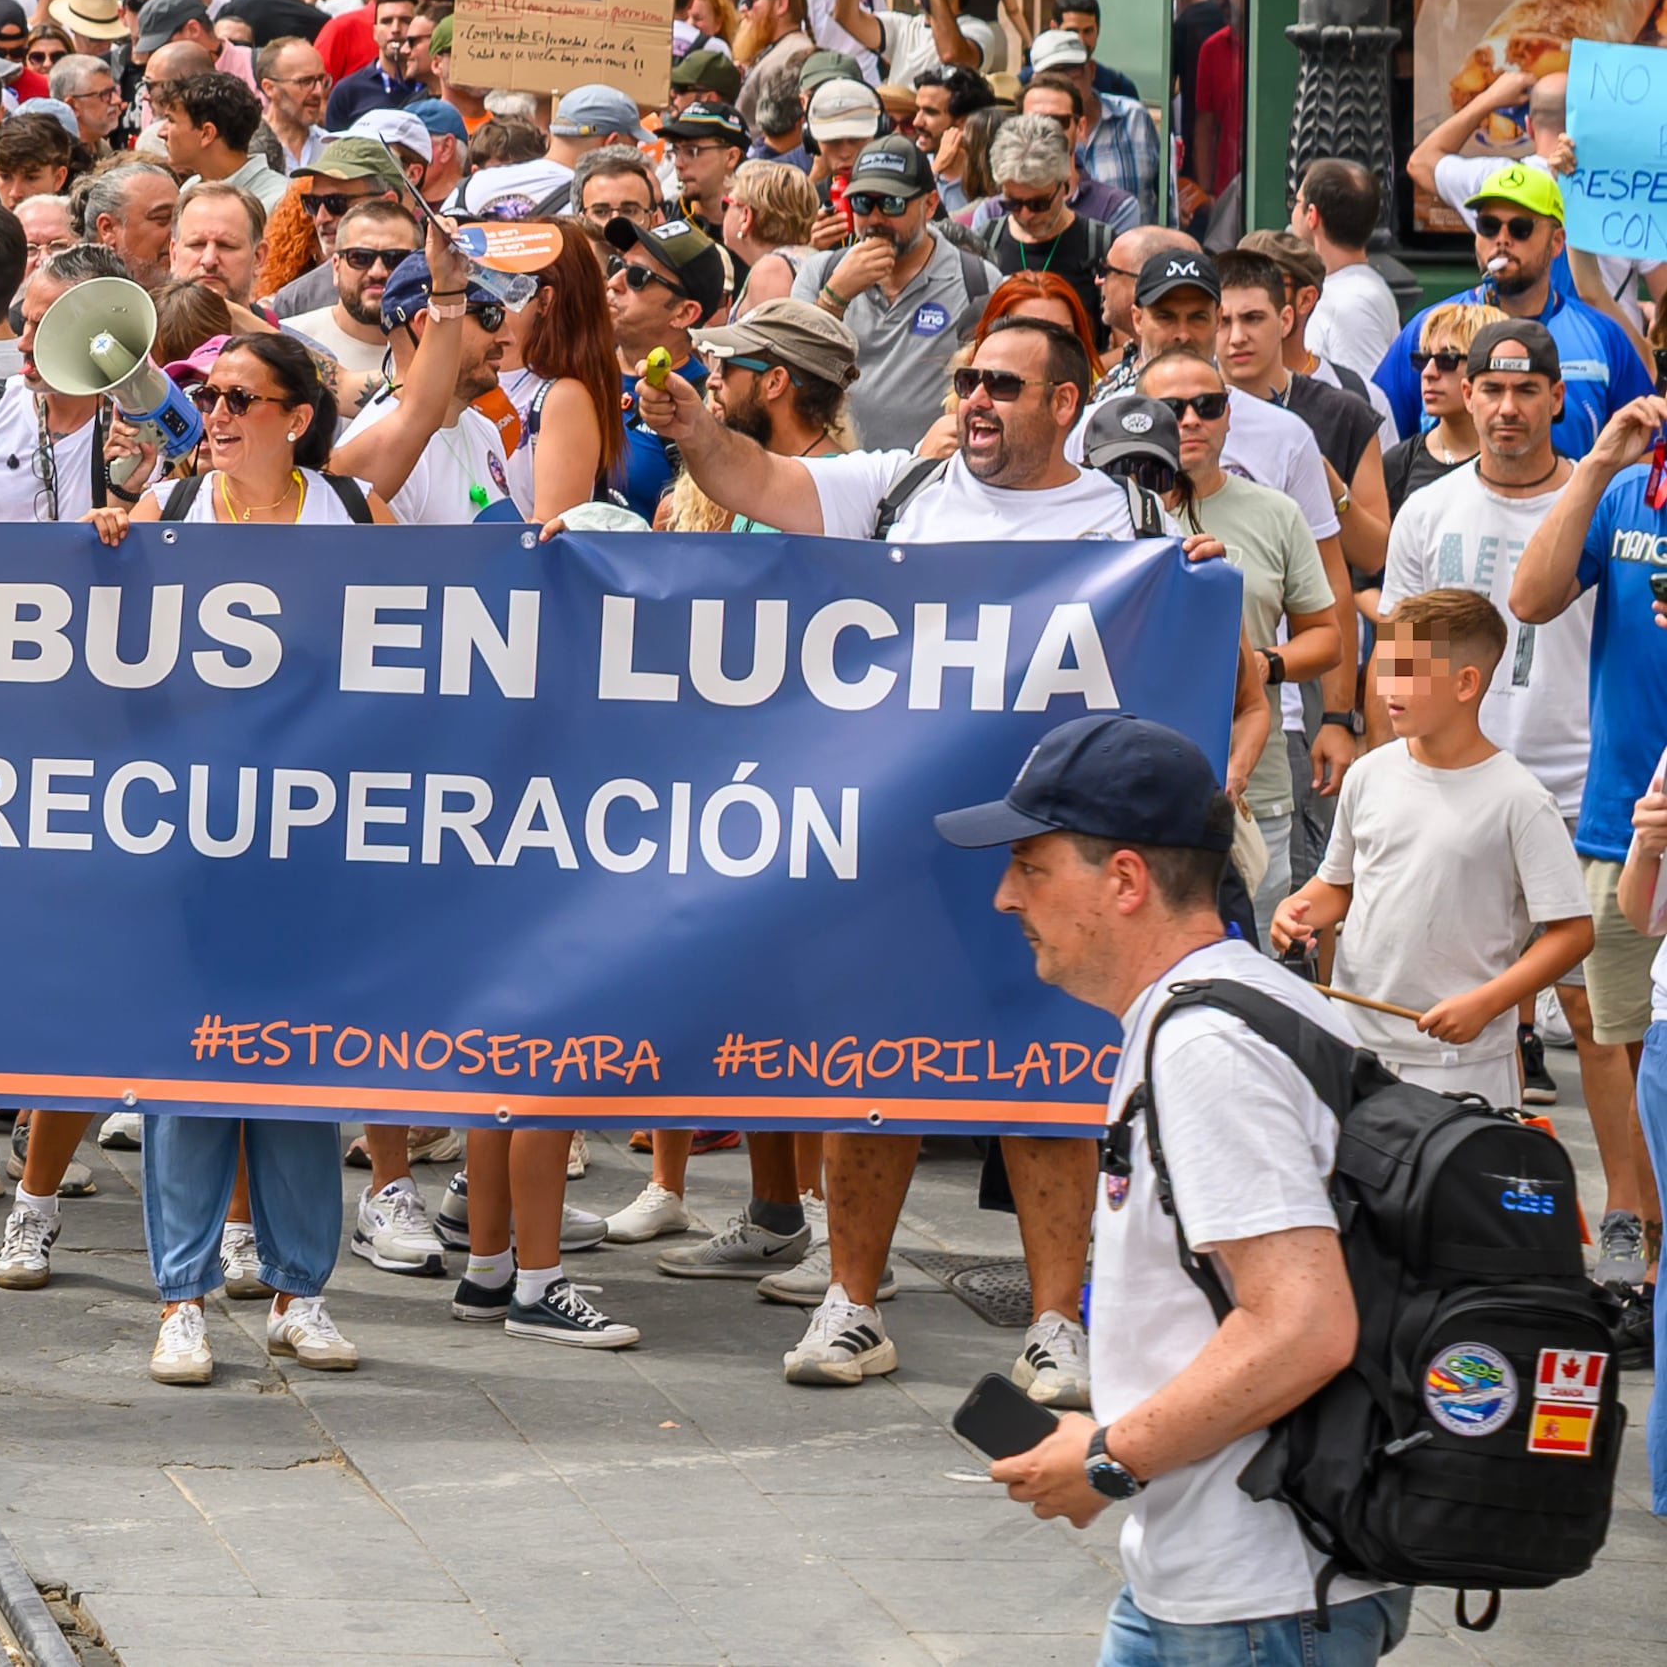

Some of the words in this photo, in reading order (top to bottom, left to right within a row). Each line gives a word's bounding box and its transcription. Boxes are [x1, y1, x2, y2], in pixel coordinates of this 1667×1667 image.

[1590, 62, 1651, 105] NO
[340, 585, 541, 699] EN
[599, 595, 1120, 712] LUCHA
[191, 1015, 660, 1084] #ESTONOSEPARA
[1501, 1190, 1555, 1214] C295
[1446, 1355, 1504, 1382] C295
